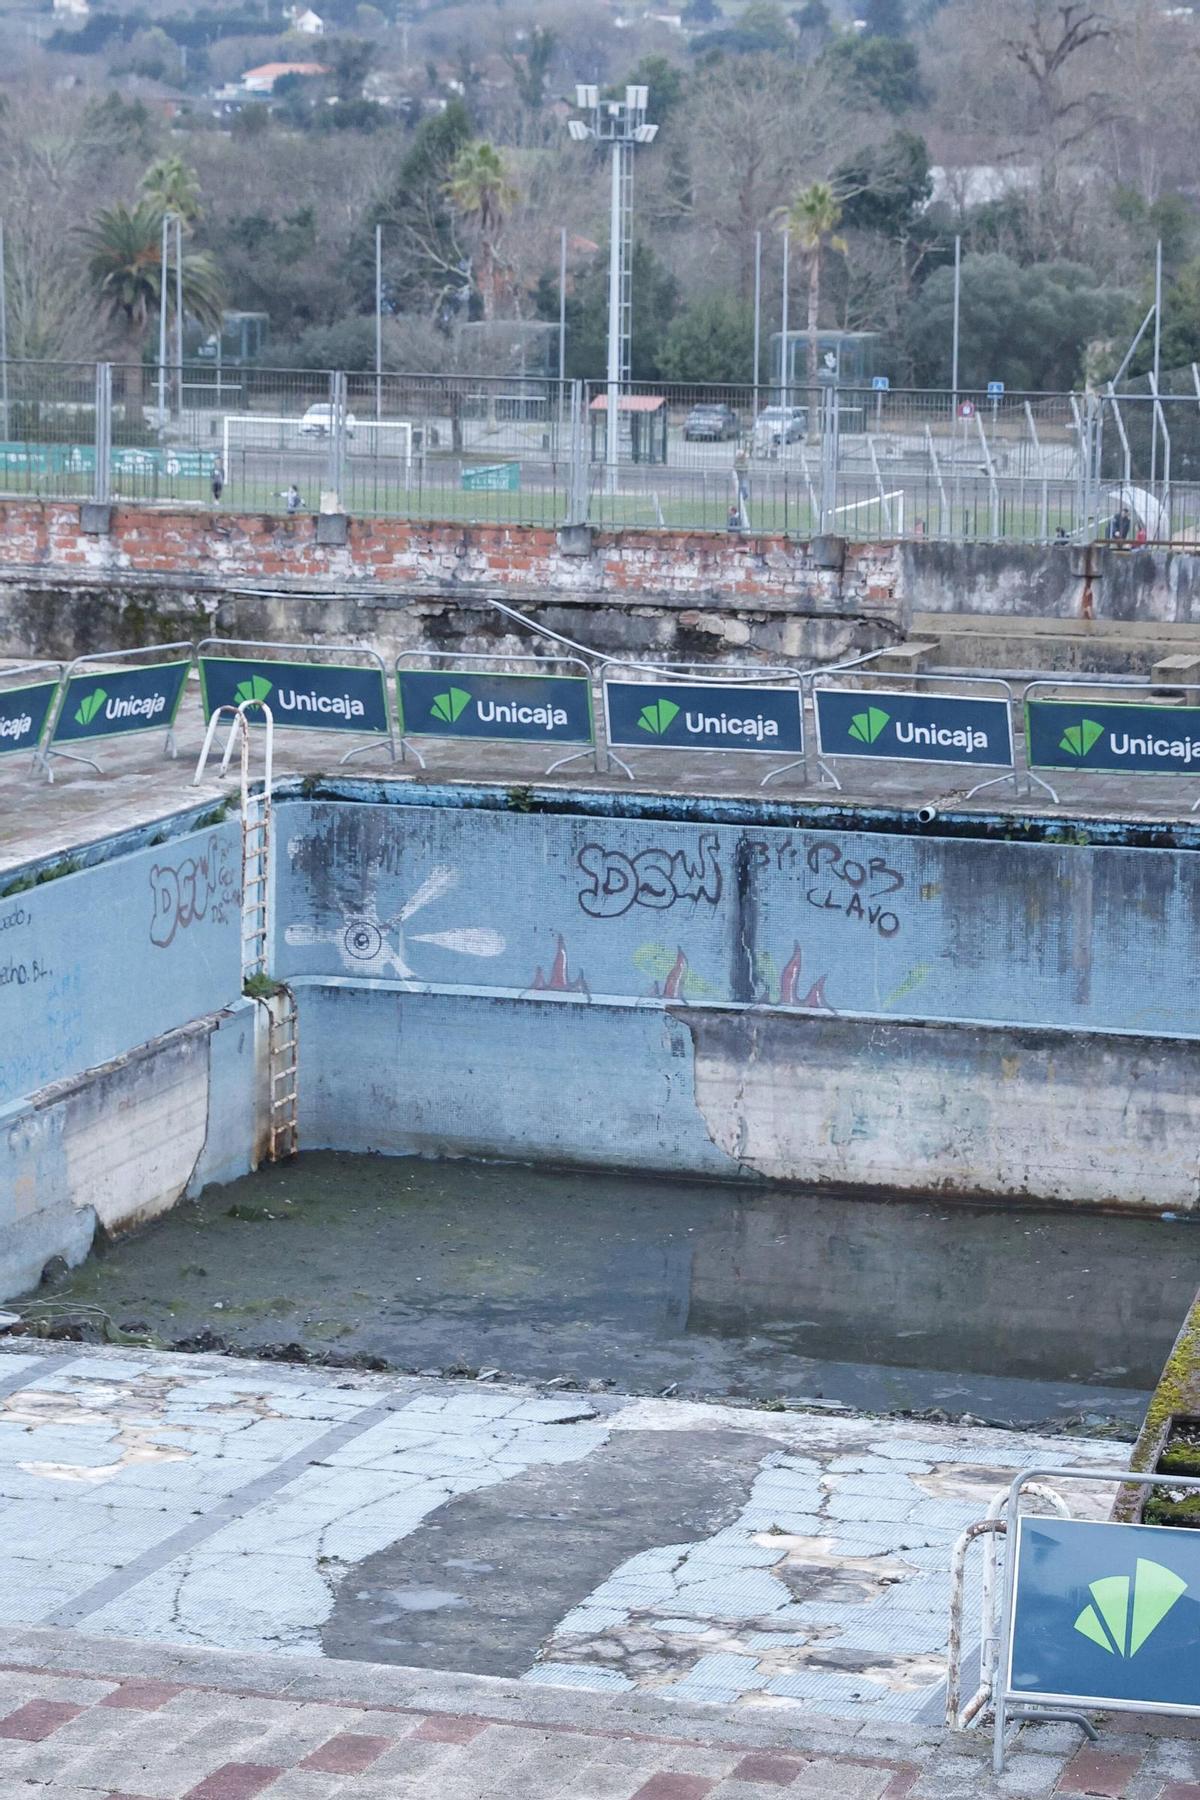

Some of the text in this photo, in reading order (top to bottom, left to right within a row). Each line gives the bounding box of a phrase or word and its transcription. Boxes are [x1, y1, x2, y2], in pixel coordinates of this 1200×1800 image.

[105, 692, 166, 721] Unicaja
[278, 689, 366, 720] Unicaja
[477, 701, 568, 730] Unicaja
[686, 712, 778, 742] Unicaja
[895, 721, 988, 753] Unicaja
[806, 887, 900, 938] CLAVO
